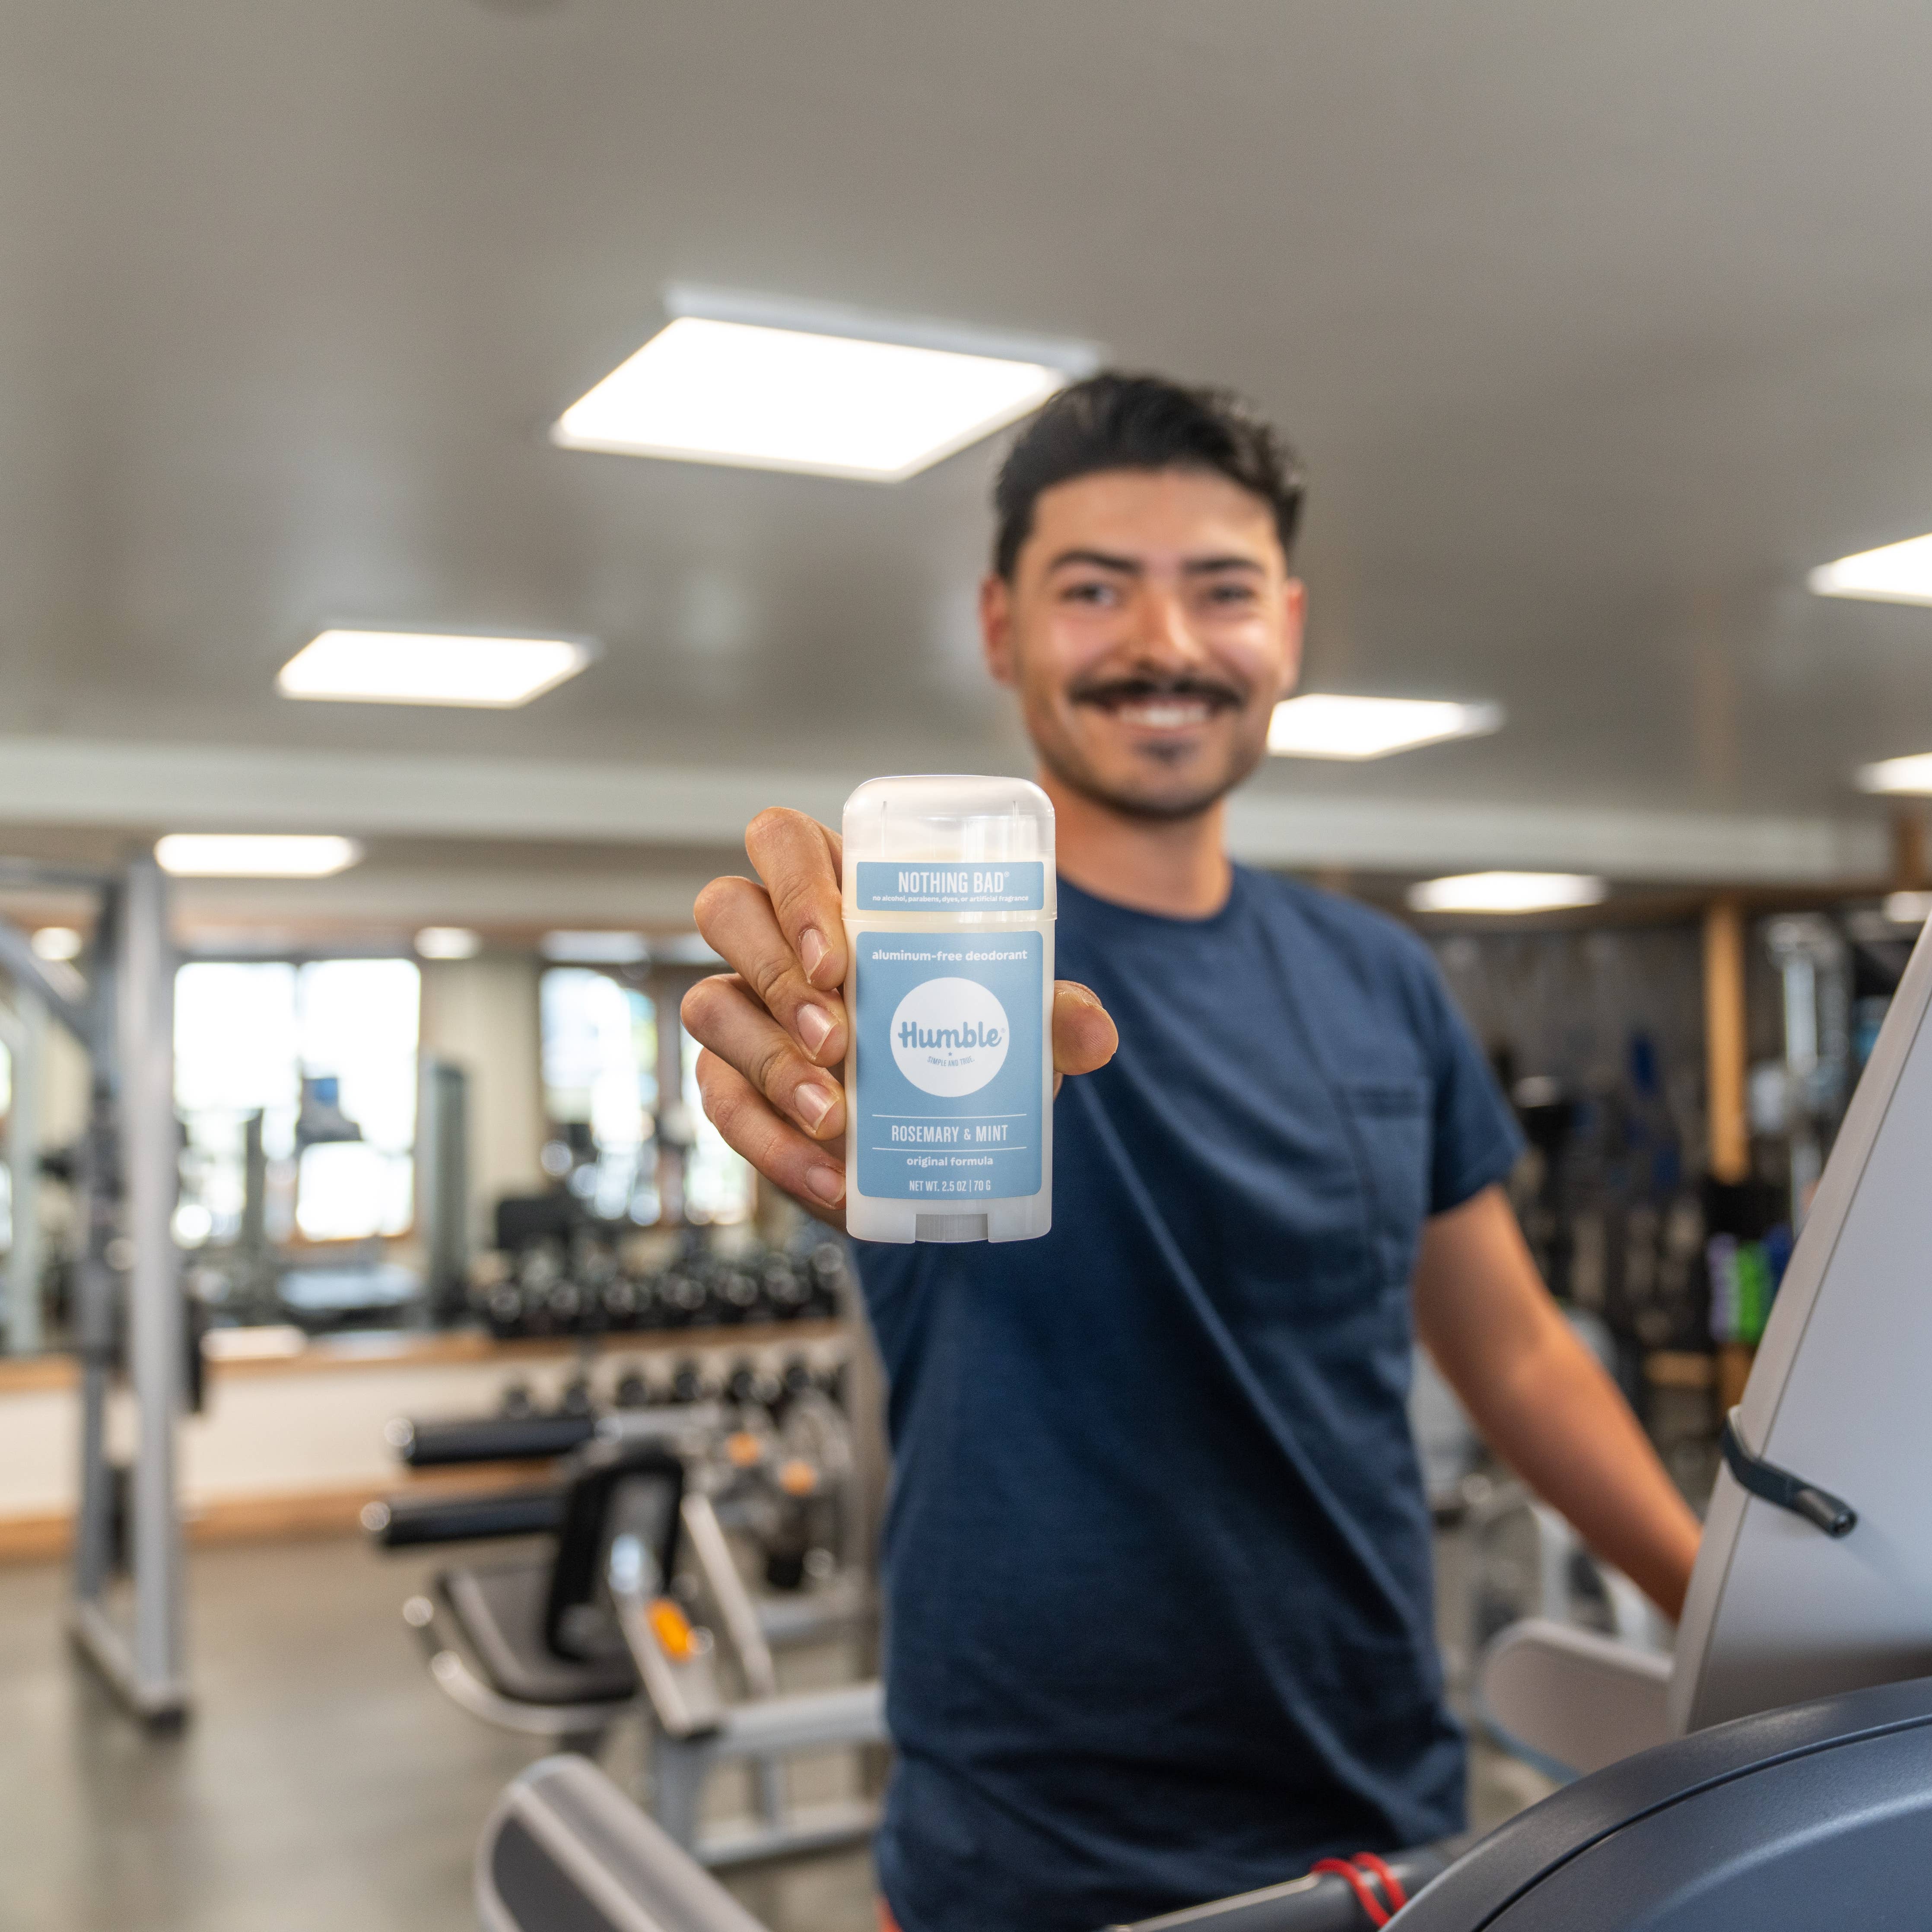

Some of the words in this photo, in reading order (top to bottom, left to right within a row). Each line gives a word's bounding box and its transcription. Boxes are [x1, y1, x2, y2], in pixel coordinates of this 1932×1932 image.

[899, 871, 968, 893] NOTHING
[872, 950, 962, 961] aluminum-free
[965, 950, 1028, 961] deodorant
[927, 1056, 947, 1067] SIMPLE
[960, 1056, 975, 1065] TRUE.
[892, 1125, 959, 1142] ROSEMARY
[964, 1128, 971, 1140] &
[976, 1125, 1008, 1141] MINT
[907, 1157, 947, 1167] original
[950, 1156, 993, 1166] formula
[909, 1180, 924, 1192] NET
[925, 1181, 940, 1192] WT.
[942, 1181, 954, 1192] 2.5
[956, 1181, 967, 1192] OZ
[974, 1180, 984, 1191] 70
[985, 1180, 991, 1191] G
